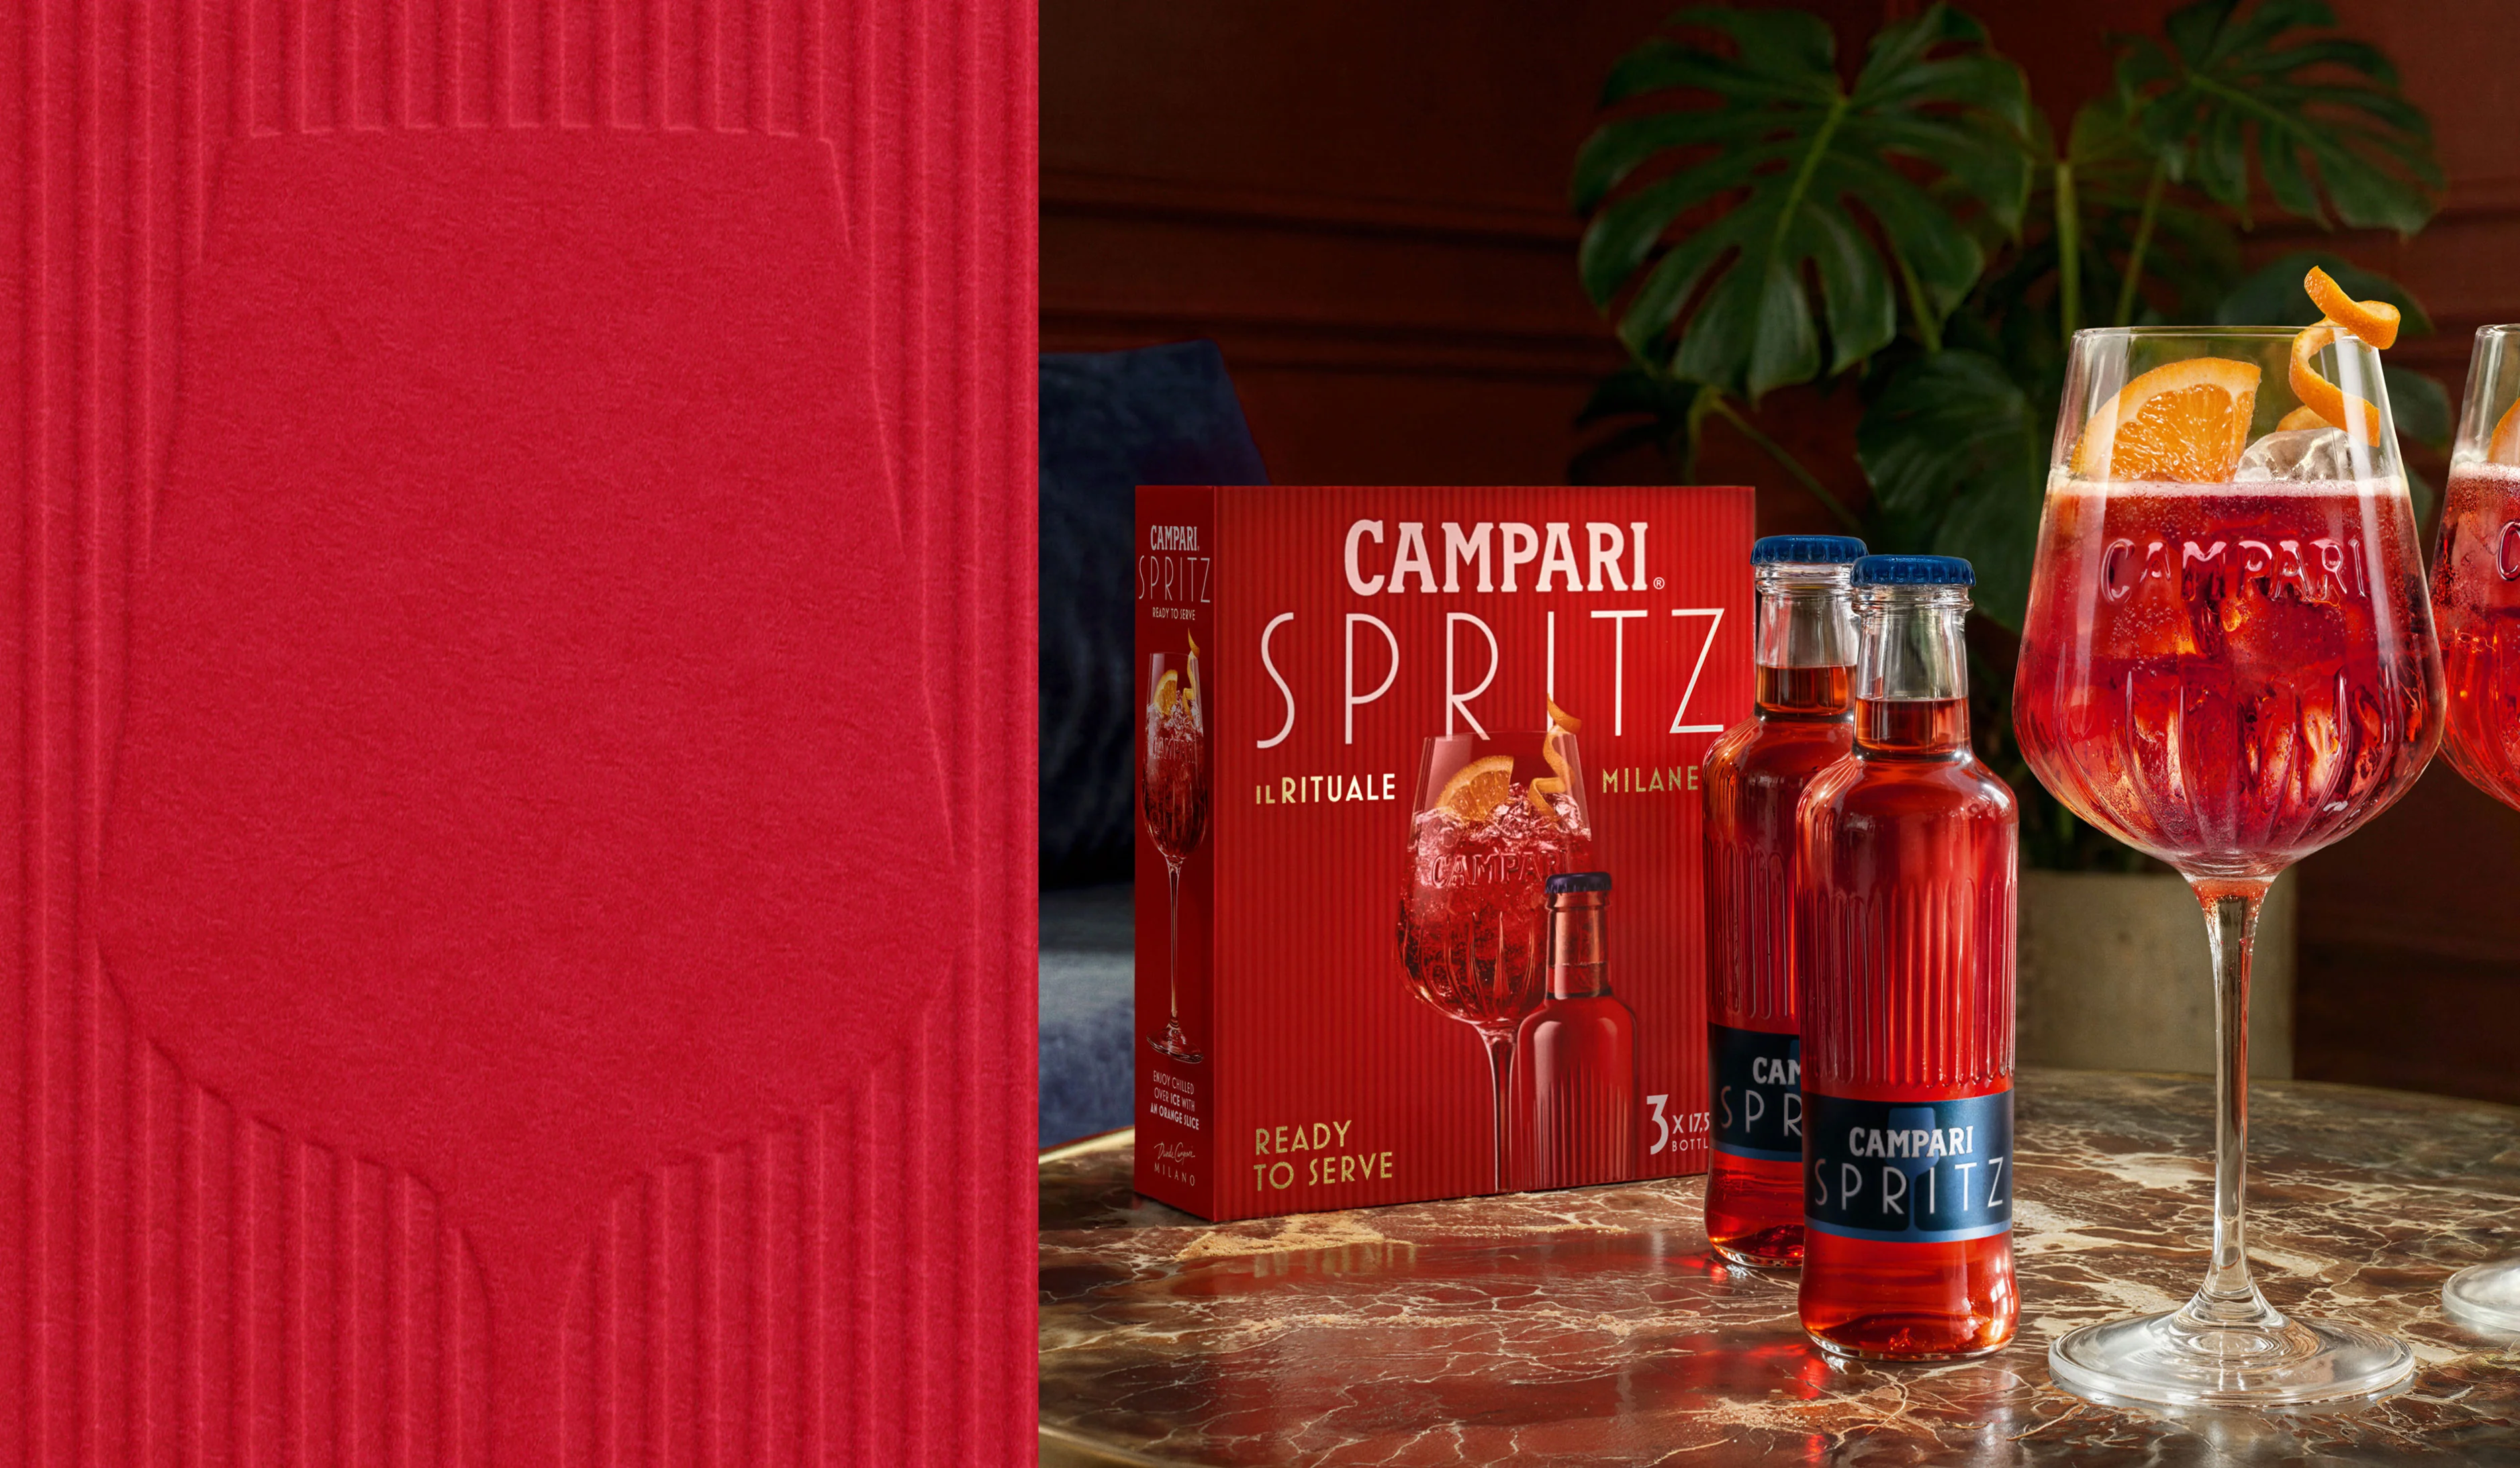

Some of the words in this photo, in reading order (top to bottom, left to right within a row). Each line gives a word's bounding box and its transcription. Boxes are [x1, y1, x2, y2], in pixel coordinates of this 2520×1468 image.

[1138, 555, 1211, 603] SPRITZ
[2101, 538, 2370, 603] CAMPARI
[1152, 607, 1170, 619] READY
[1170, 608, 1179, 620] TO
[1180, 609, 1196, 621] SERVE
[1256, 607, 1725, 749] SPRITZ
[1256, 785, 1276, 805] IL
[1281, 773, 1395, 804] RITUALE
[1602, 765, 1699, 794] MILANE
[1153, 1070, 1171, 1087] ENJOY
[1172, 1077, 1194, 1095] CHILLED
[1154, 1087, 1169, 1103] OVER
[1170, 1093, 1180, 1107] ICE
[1181, 1097, 1195, 1112] WITH
[1150, 1102, 1158, 1114] AN
[1159, 1105, 1182, 1124] ORANGE
[1184, 1114, 1199, 1130] SLICE
[1646, 1094, 1669, 1155] 3
[1255, 1120, 1352, 1155] READY
[1672, 1138, 1708, 1152] BOTTL
[1849, 1126, 1973, 1158] CAMPARI
[1154, 1162, 1195, 1187] MILANO
[1253, 1161, 1295, 1191] TO
[1309, 1152, 1393, 1186] SERVE
[1814, 1157, 2004, 1215] SPRITZ
